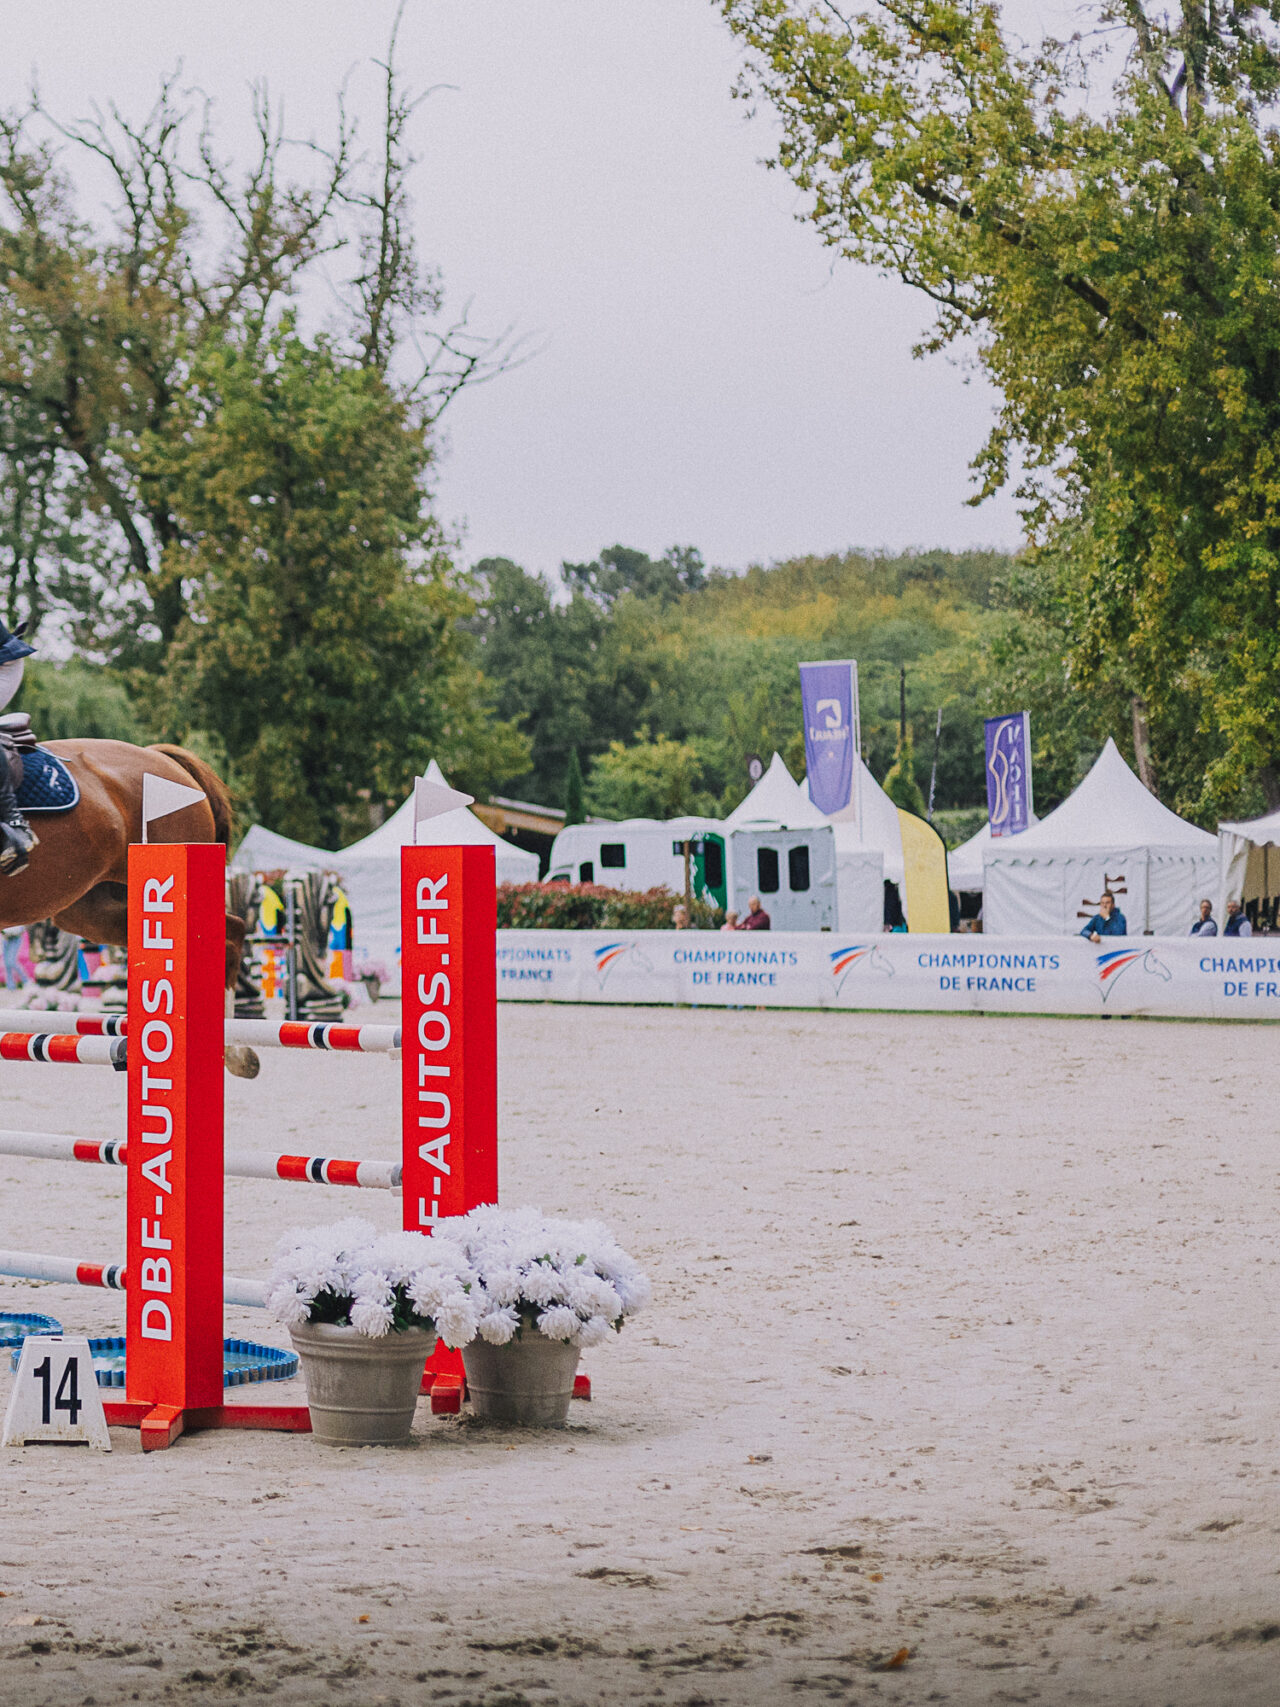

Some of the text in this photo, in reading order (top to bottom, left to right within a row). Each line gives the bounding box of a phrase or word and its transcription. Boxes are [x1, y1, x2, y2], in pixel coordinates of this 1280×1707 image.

[496, 948, 572, 962] PIONNATS
[673, 949, 798, 966] CHAMPIONNATS
[918, 953, 1060, 970] CHAMPIONNATS
[501, 969, 553, 982] FRANCE
[692, 971, 777, 987] DE FRANCE
[939, 976, 1036, 992] DE FRANCE
[1223, 981, 1280, 998] DE FR
[416, 872, 451, 1227] F-AUTOS.FR
[141, 874, 174, 1342] DBF-AUTOS.FR
[33, 1356, 82, 1425] 14
